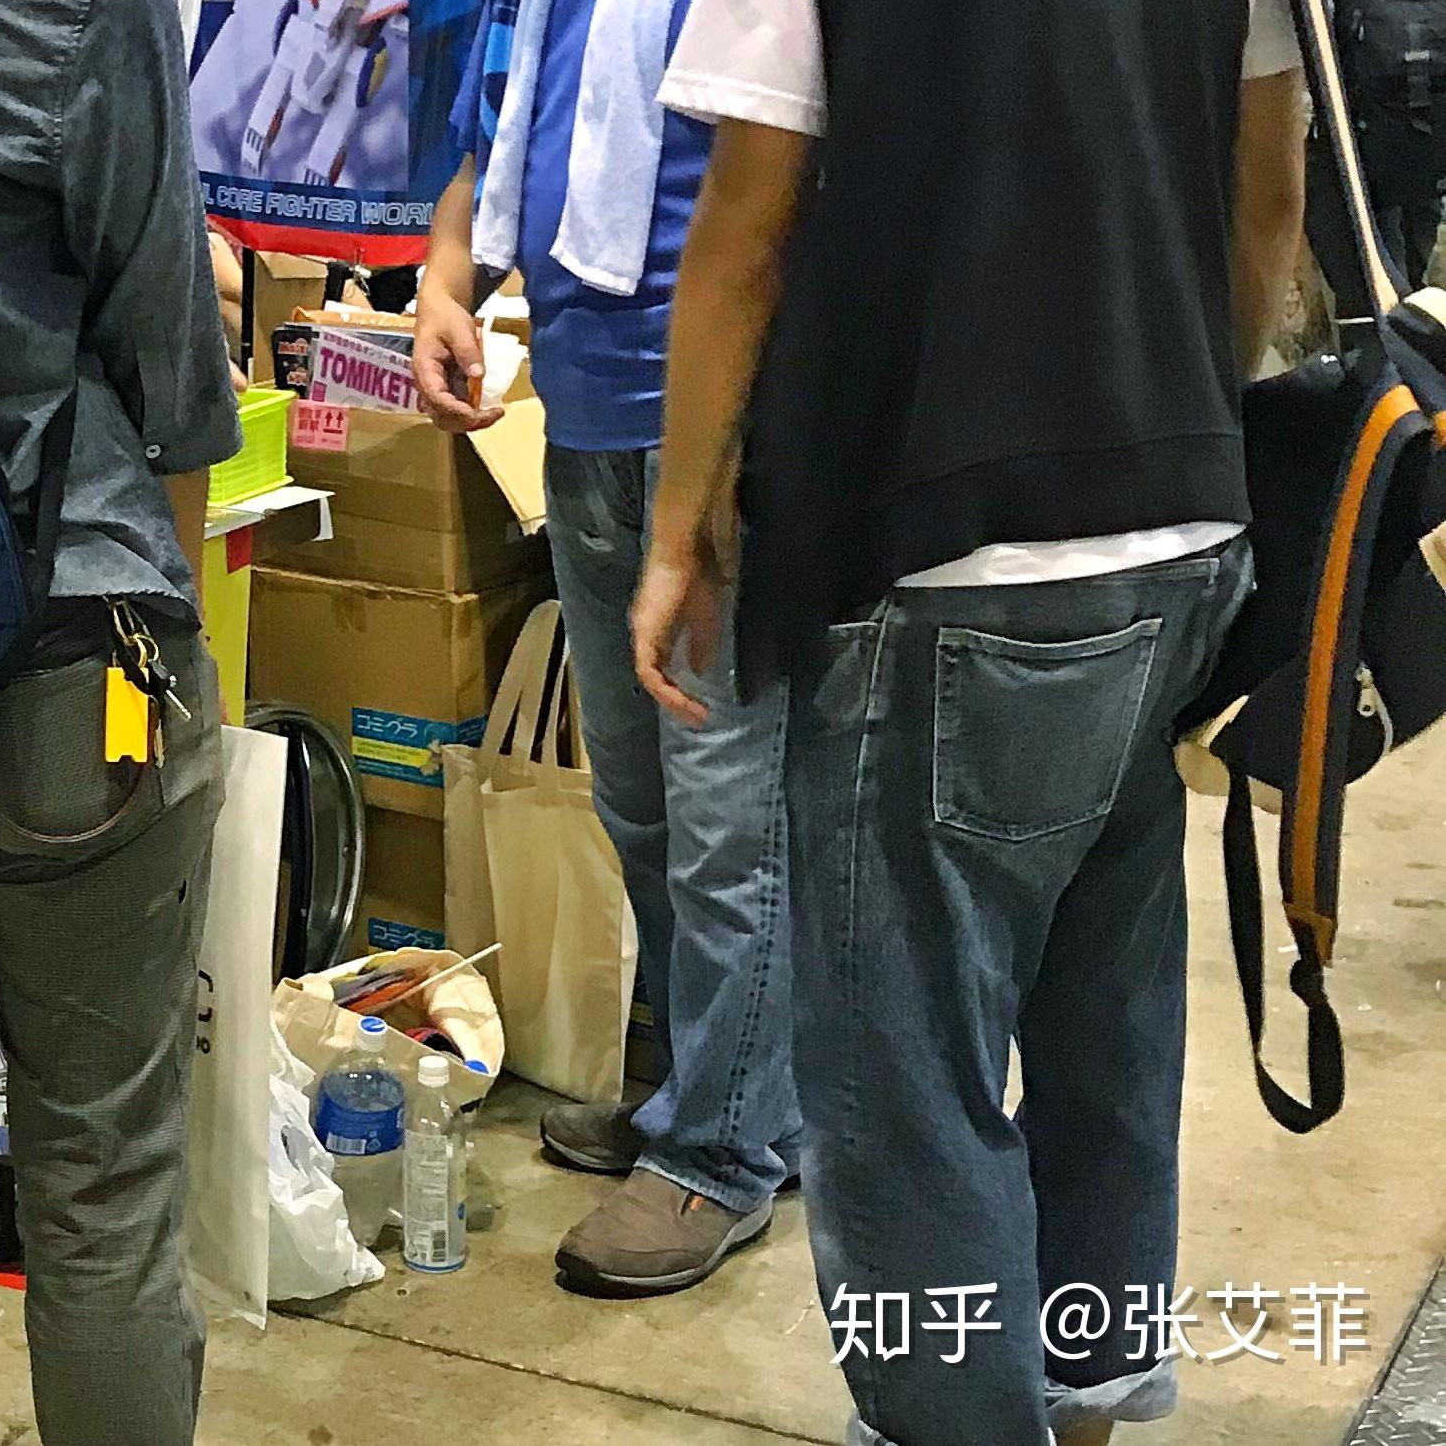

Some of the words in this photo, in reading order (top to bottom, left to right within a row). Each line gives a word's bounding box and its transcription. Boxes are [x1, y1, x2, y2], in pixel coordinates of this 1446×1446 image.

[216, 185, 263, 213] CORE
[265, 192, 357, 223] FIGHTER
[319, 346, 417, 410] TOMIKET
[357, 714, 419, 738] コミグラ
